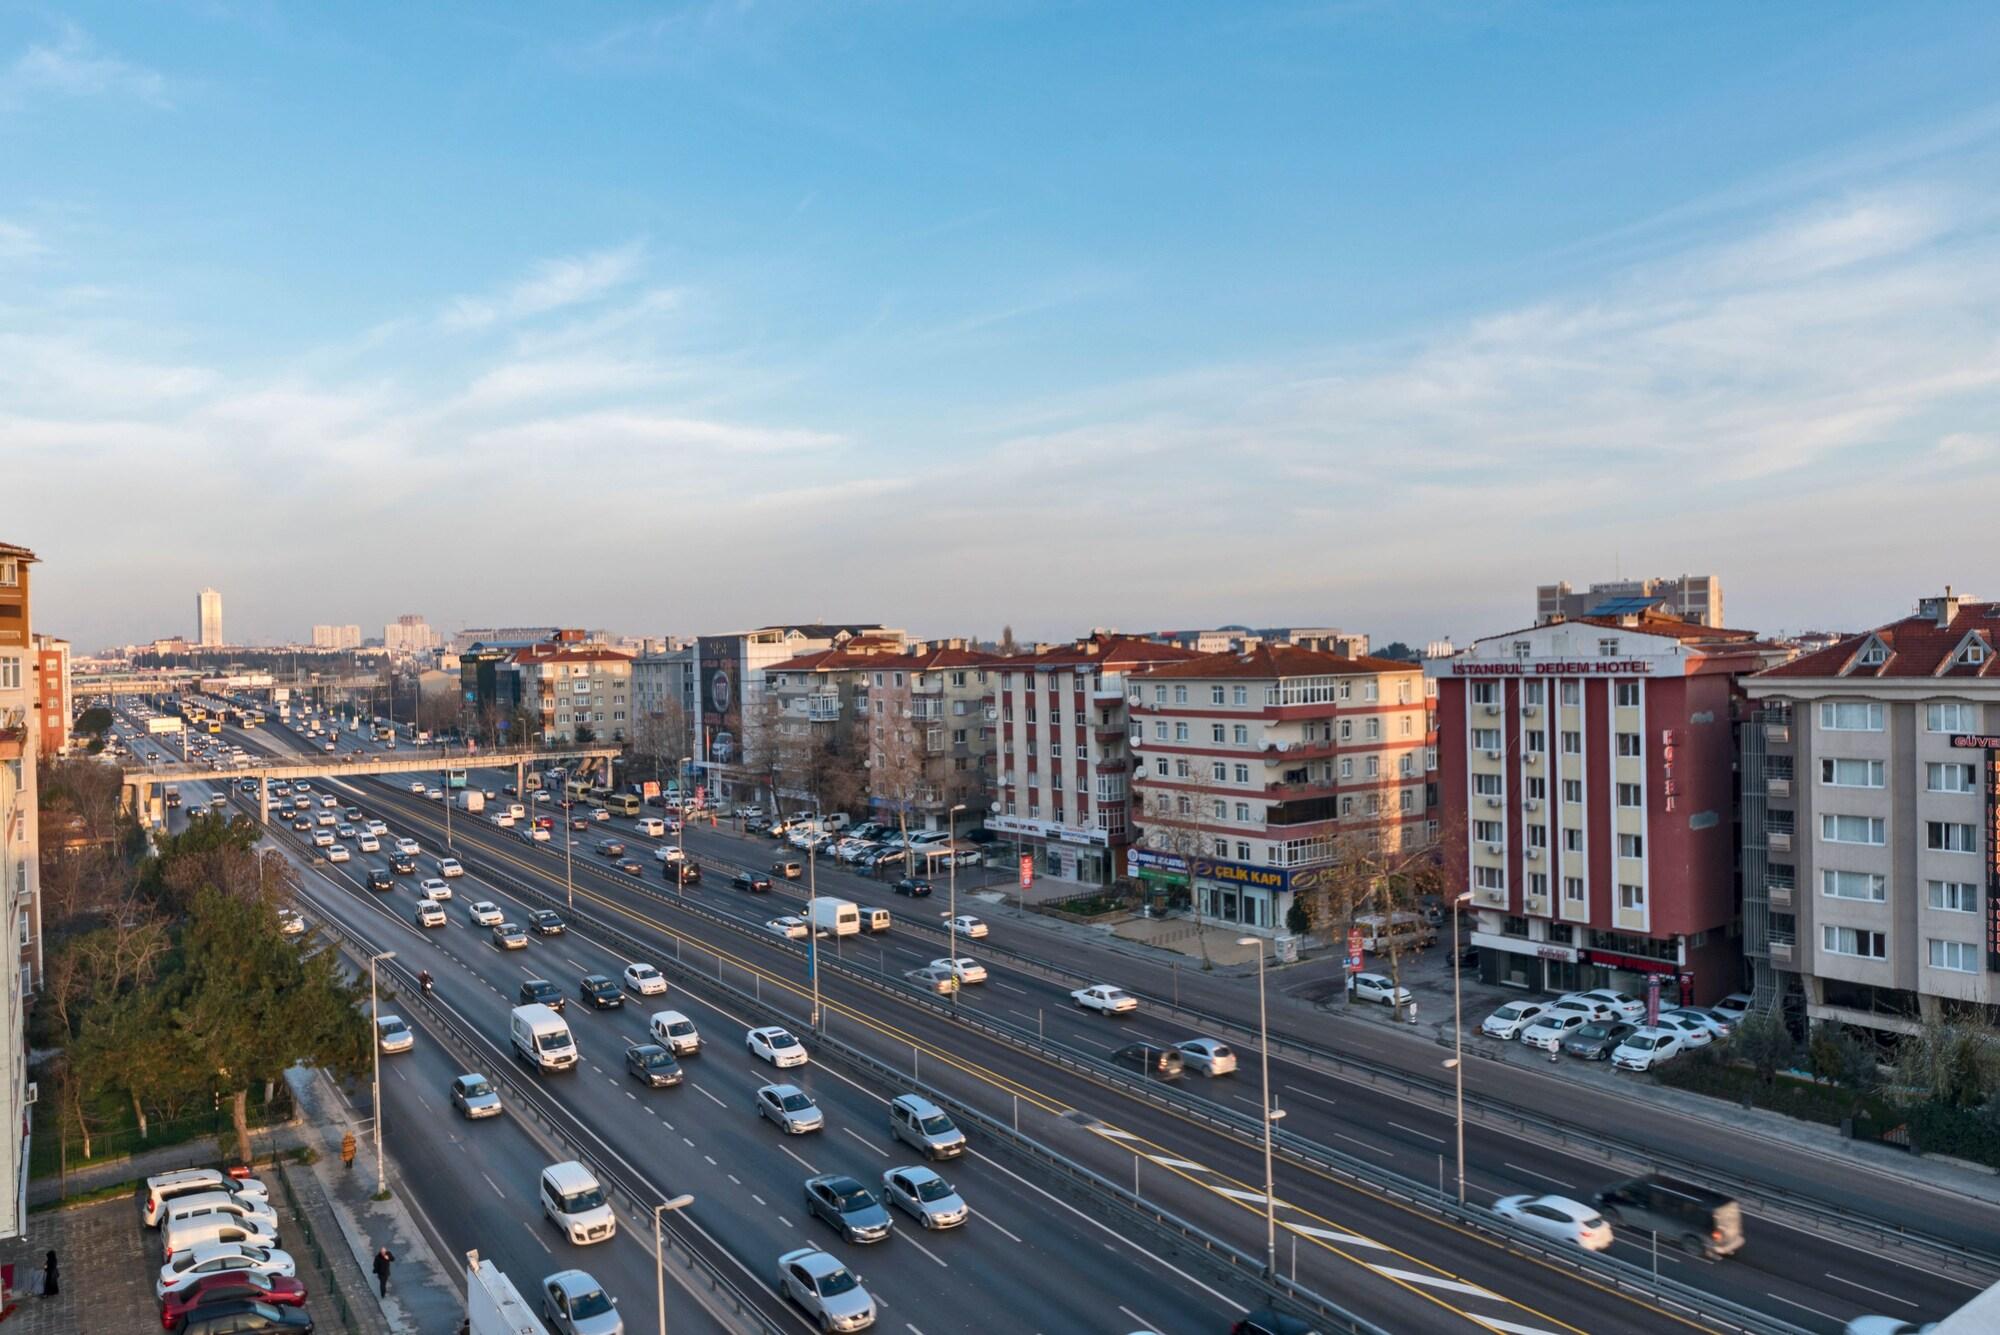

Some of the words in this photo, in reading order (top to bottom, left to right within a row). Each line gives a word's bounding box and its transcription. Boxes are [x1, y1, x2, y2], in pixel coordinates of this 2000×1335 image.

[1535, 661, 1590, 675] DEDEM
[1596, 660, 1650, 674] HOTEL
[1215, 865, 1249, 882] ÇELİK
[1250, 871, 1282, 886] KAPI
